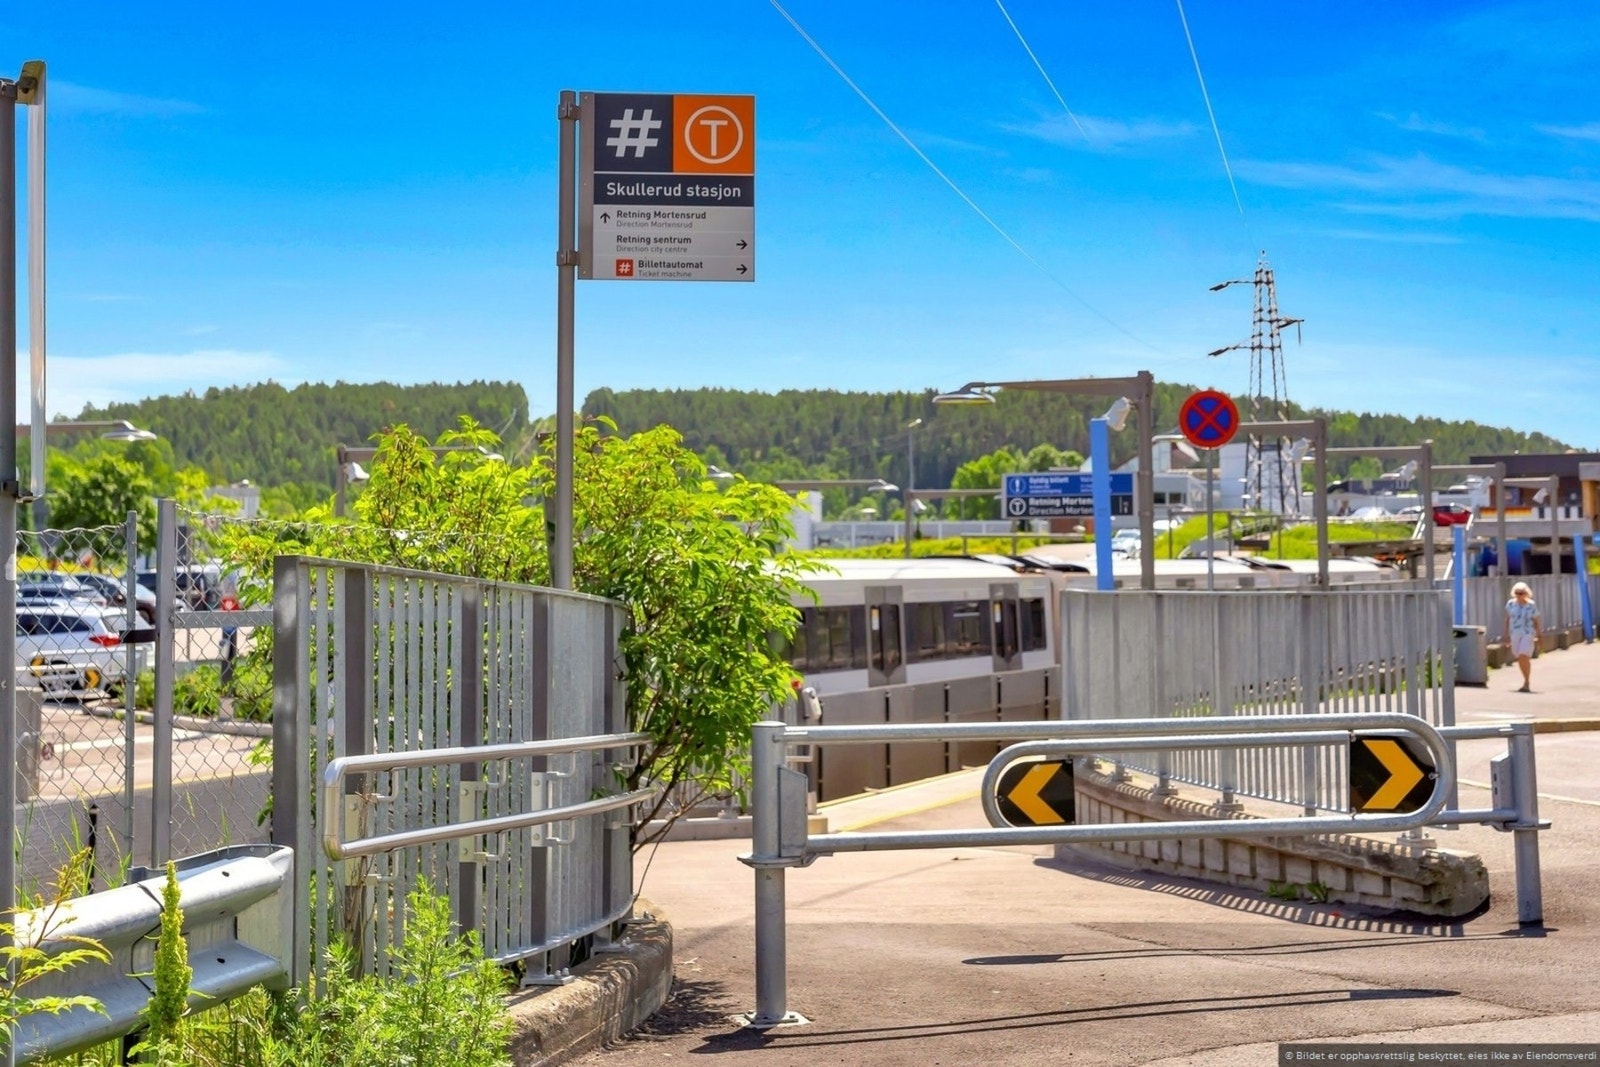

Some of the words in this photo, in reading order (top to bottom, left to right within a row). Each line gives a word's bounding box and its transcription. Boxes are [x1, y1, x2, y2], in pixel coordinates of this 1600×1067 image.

[699, 119, 728, 157] T
[606, 182, 682, 197] Skullerud
[686, 183, 742, 200] stasjon
[617, 209, 651, 220] Retning
[653, 210, 707, 220] Mortensrud
[617, 220, 649, 228] Direction
[651, 221, 693, 229] Mortensrud
[617, 234, 651, 245] Retning
[653, 236, 692, 244] sentrum
[617, 245, 649, 253] Direction
[651, 246, 663, 254] city
[638, 259, 703, 269] Billettautomat
[638, 269, 660, 277] Ticket
[661, 270, 692, 278] machine
[1029, 497, 1060, 508] Retning
[1062, 496, 1094, 506] Morten
[1029, 506, 1064, 516] Direction
[1066, 505, 1094, 515] Morten
